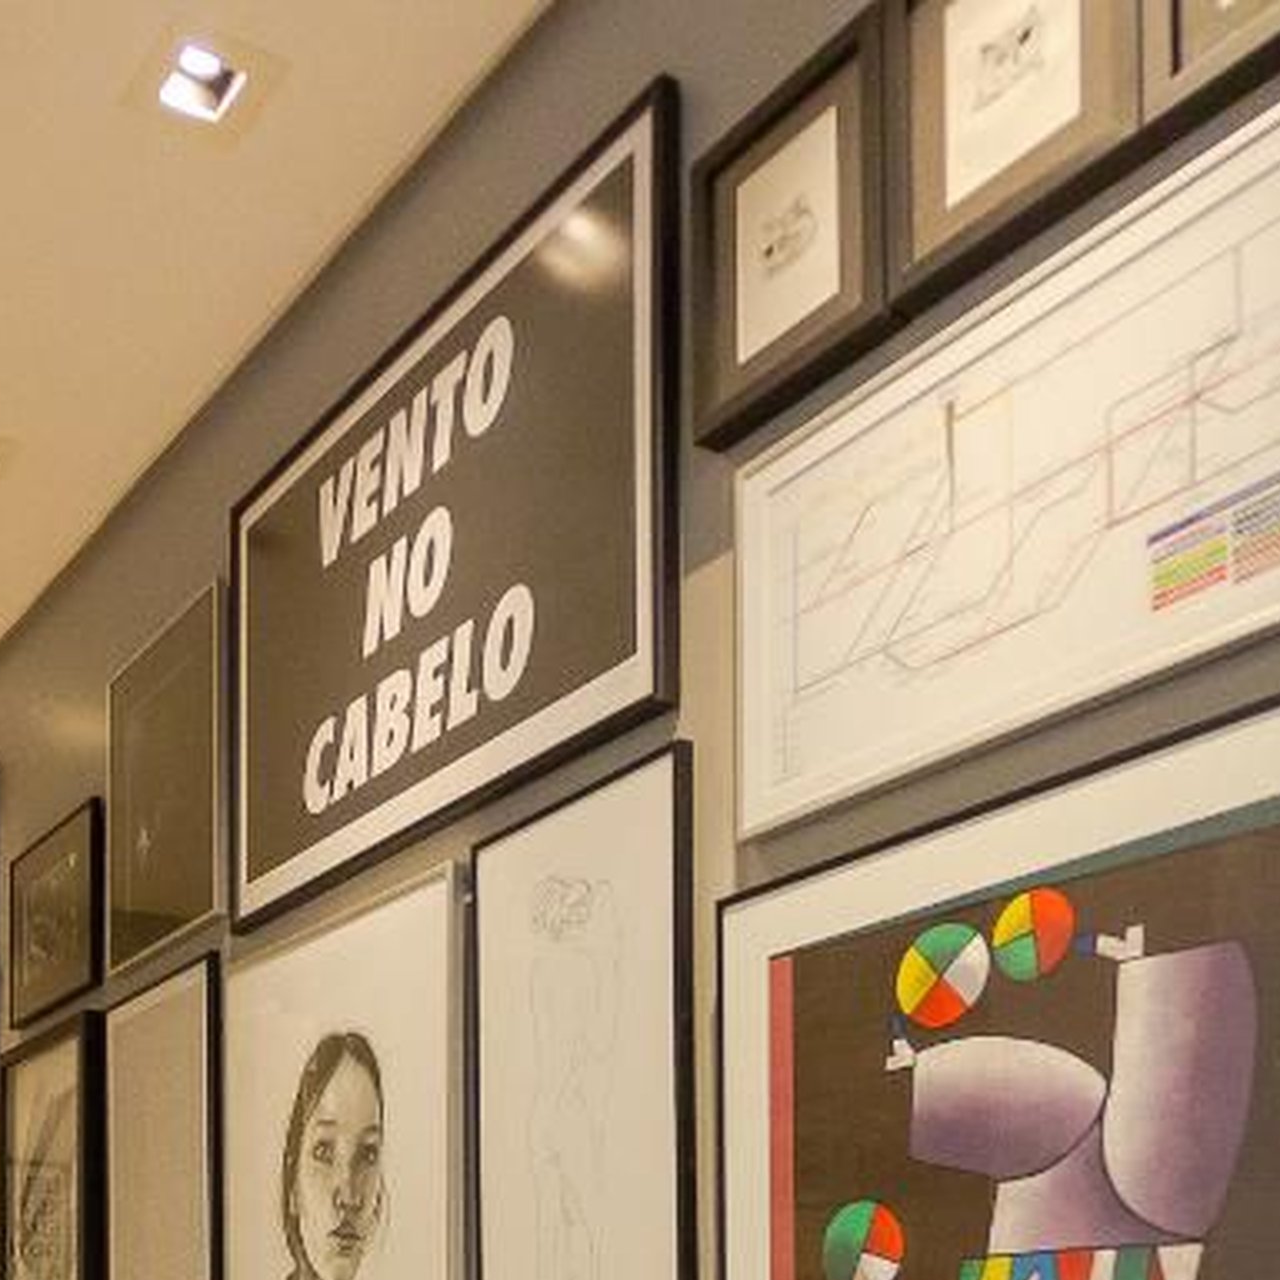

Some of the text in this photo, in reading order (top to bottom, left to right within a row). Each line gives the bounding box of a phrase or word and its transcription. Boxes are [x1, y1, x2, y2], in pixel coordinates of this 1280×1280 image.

[319, 316, 514, 569] VENTO
[362, 505, 453, 659] NO
[303, 583, 535, 814] CABELO
